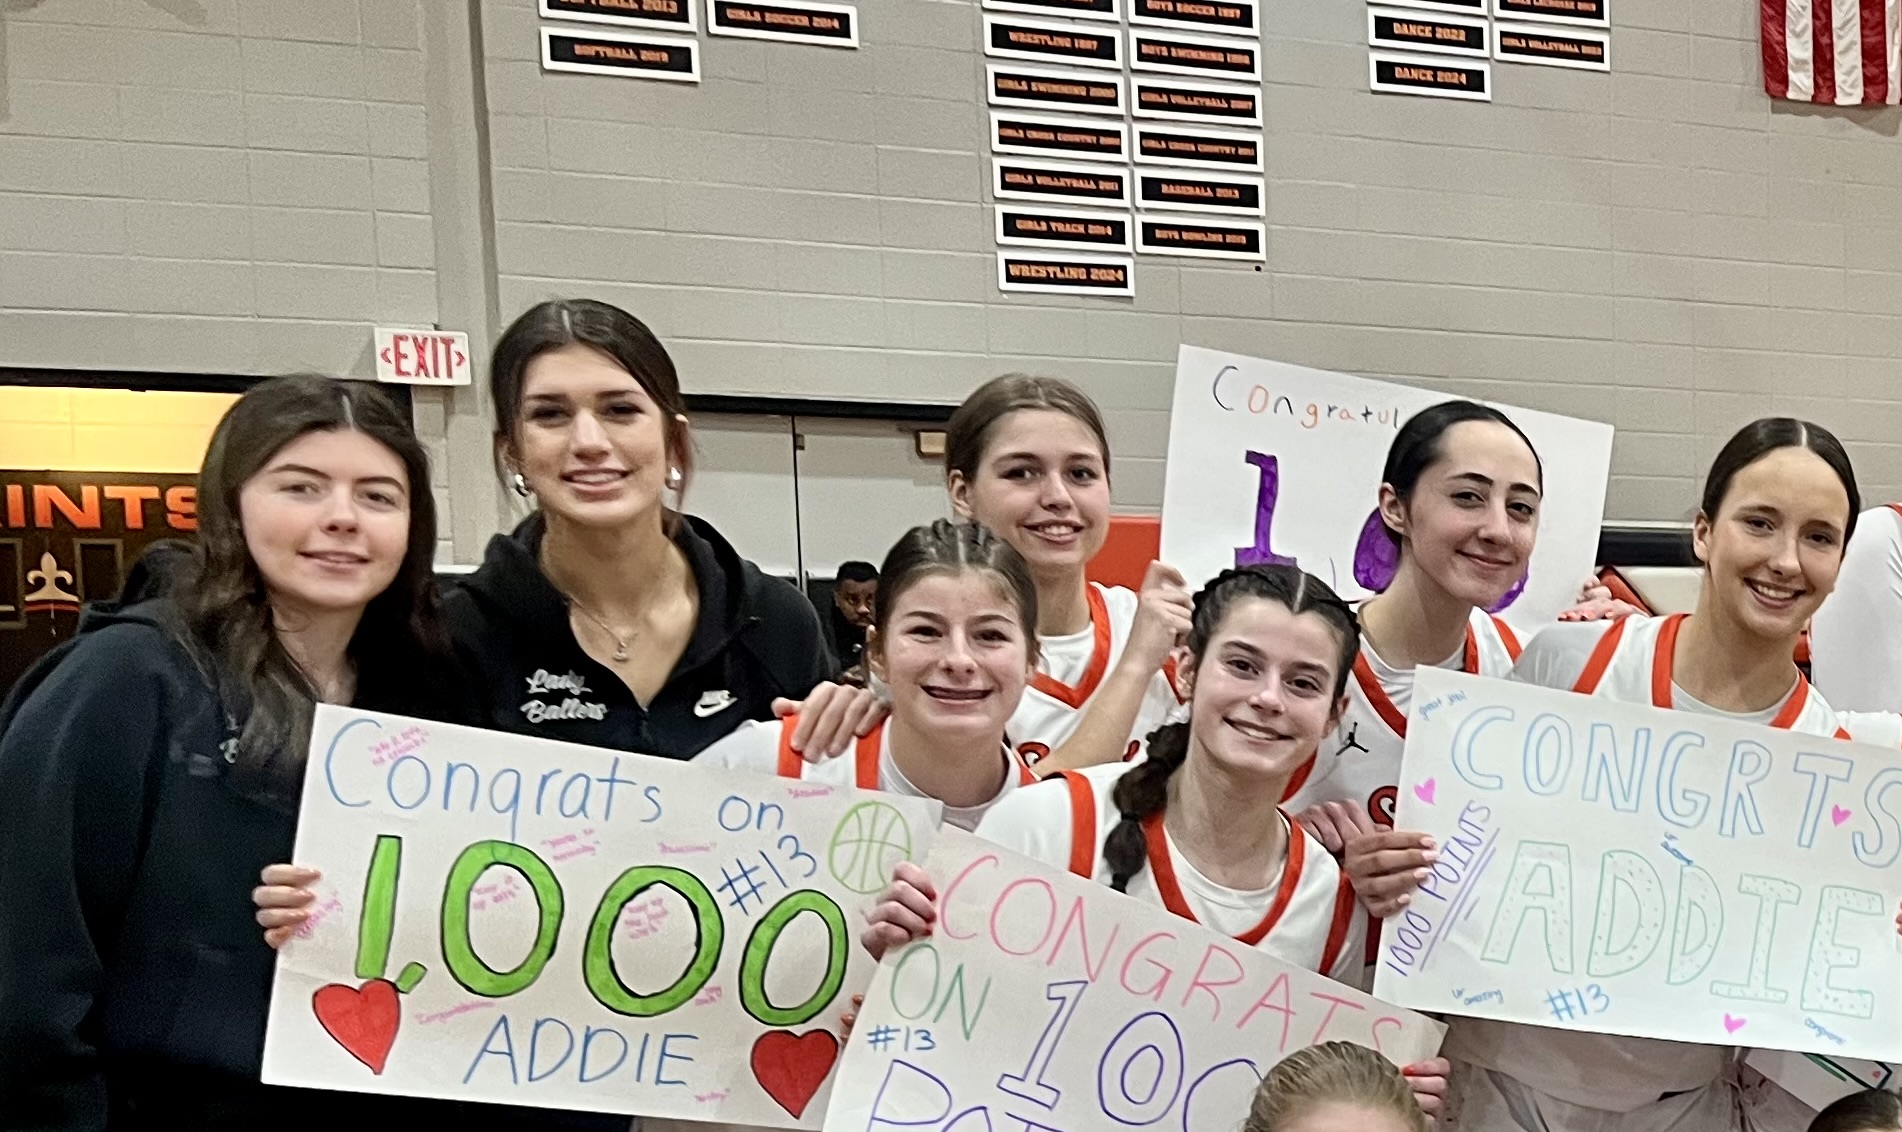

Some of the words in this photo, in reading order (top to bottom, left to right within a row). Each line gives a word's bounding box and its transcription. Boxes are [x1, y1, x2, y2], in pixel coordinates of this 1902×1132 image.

[1009, 264, 1086, 280] WRESTLING
[393, 334, 455, 380] EXIT
[1212, 364, 1400, 431] Congratul
[3, 484, 198, 530] INTS
[325, 718, 663, 843] Congrats
[717, 794, 785, 834] on
[716, 834, 817, 917] #13
[1386, 911, 1433, 977] 1000
[1420, 800, 1493, 901] POINTS
[1481, 839, 1885, 1020] ADDIE
[890, 943, 992, 1042] ON
[1546, 983, 1611, 1022] #13
[463, 1012, 701, 1087] ADDIE
[867, 1026, 938, 1053] #13
